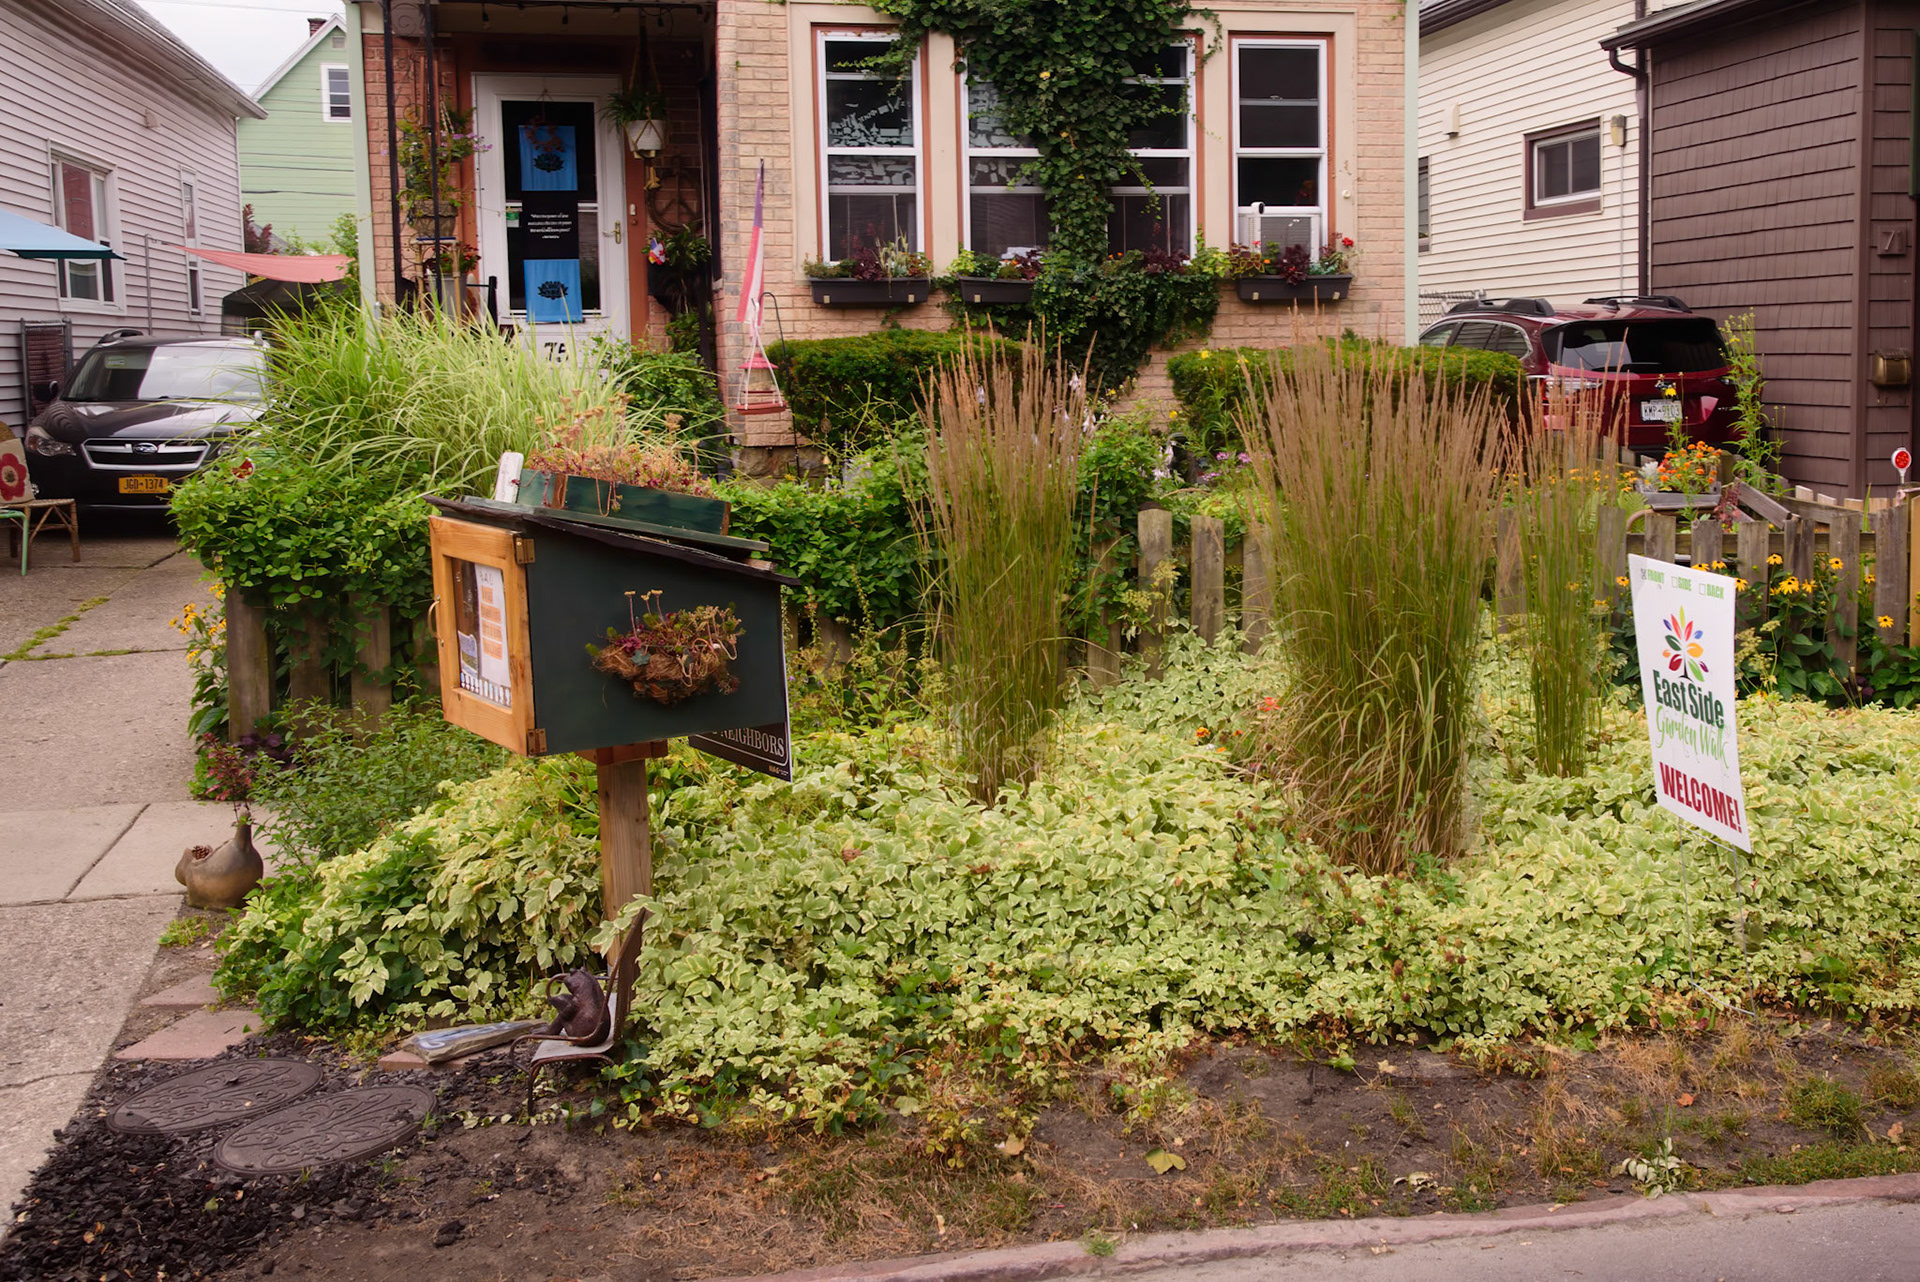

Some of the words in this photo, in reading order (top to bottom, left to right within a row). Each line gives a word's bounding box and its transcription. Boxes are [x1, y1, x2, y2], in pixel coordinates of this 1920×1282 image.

[1647, 569, 1665, 584] FRONT
[1677, 576, 1692, 592] SIDE
[1707, 583, 1724, 600] BACK
[1653, 669, 1688, 715] East
[1688, 682, 1725, 729] Side
[1656, 705, 1698, 756] Garden
[1699, 722, 1730, 769] Walk
[1659, 761, 1743, 834] WELCOME!
